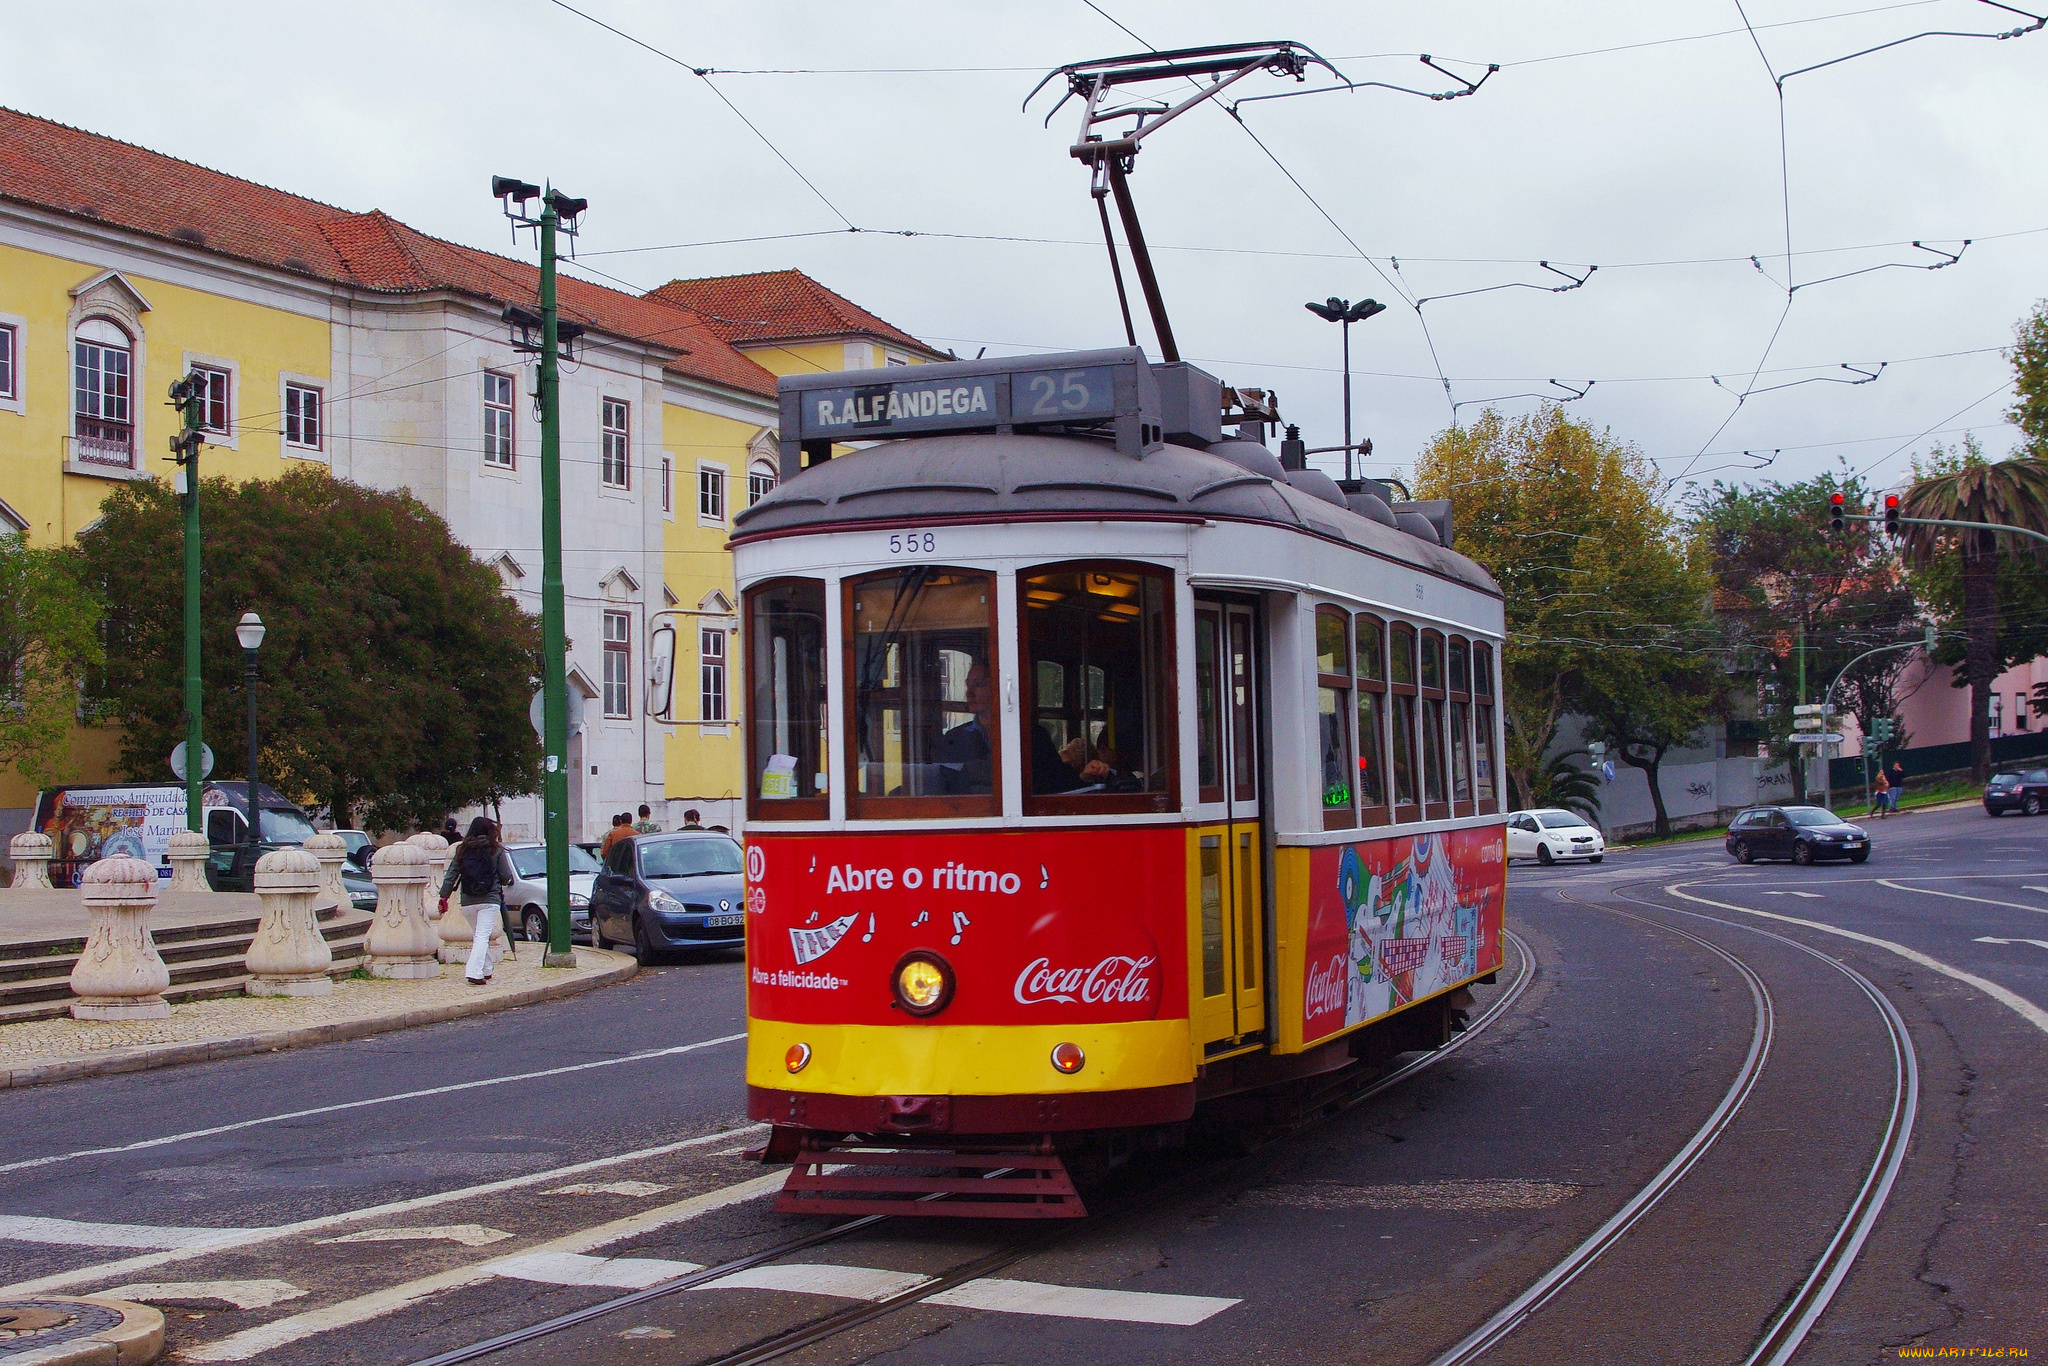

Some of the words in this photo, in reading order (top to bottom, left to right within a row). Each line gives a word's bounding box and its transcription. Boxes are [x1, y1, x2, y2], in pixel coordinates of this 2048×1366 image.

[1029, 371, 1091, 416] 25
[890, 532, 935, 553] 558
[62, 793, 126, 807] Compramos
[112, 808, 149, 817] RECHEIO
[152, 808, 165, 816] DE
[121, 824, 144, 839] José
[826, 864, 894, 894] Abre
[902, 867, 923, 889] o
[932, 861, 1021, 894] ritmo
[752, 967, 769, 984] Abre
[770, 973, 777, 985] a
[1013, 955, 1157, 1004] Coca-Cola
[1305, 952, 1348, 1020] Coca-Cola
